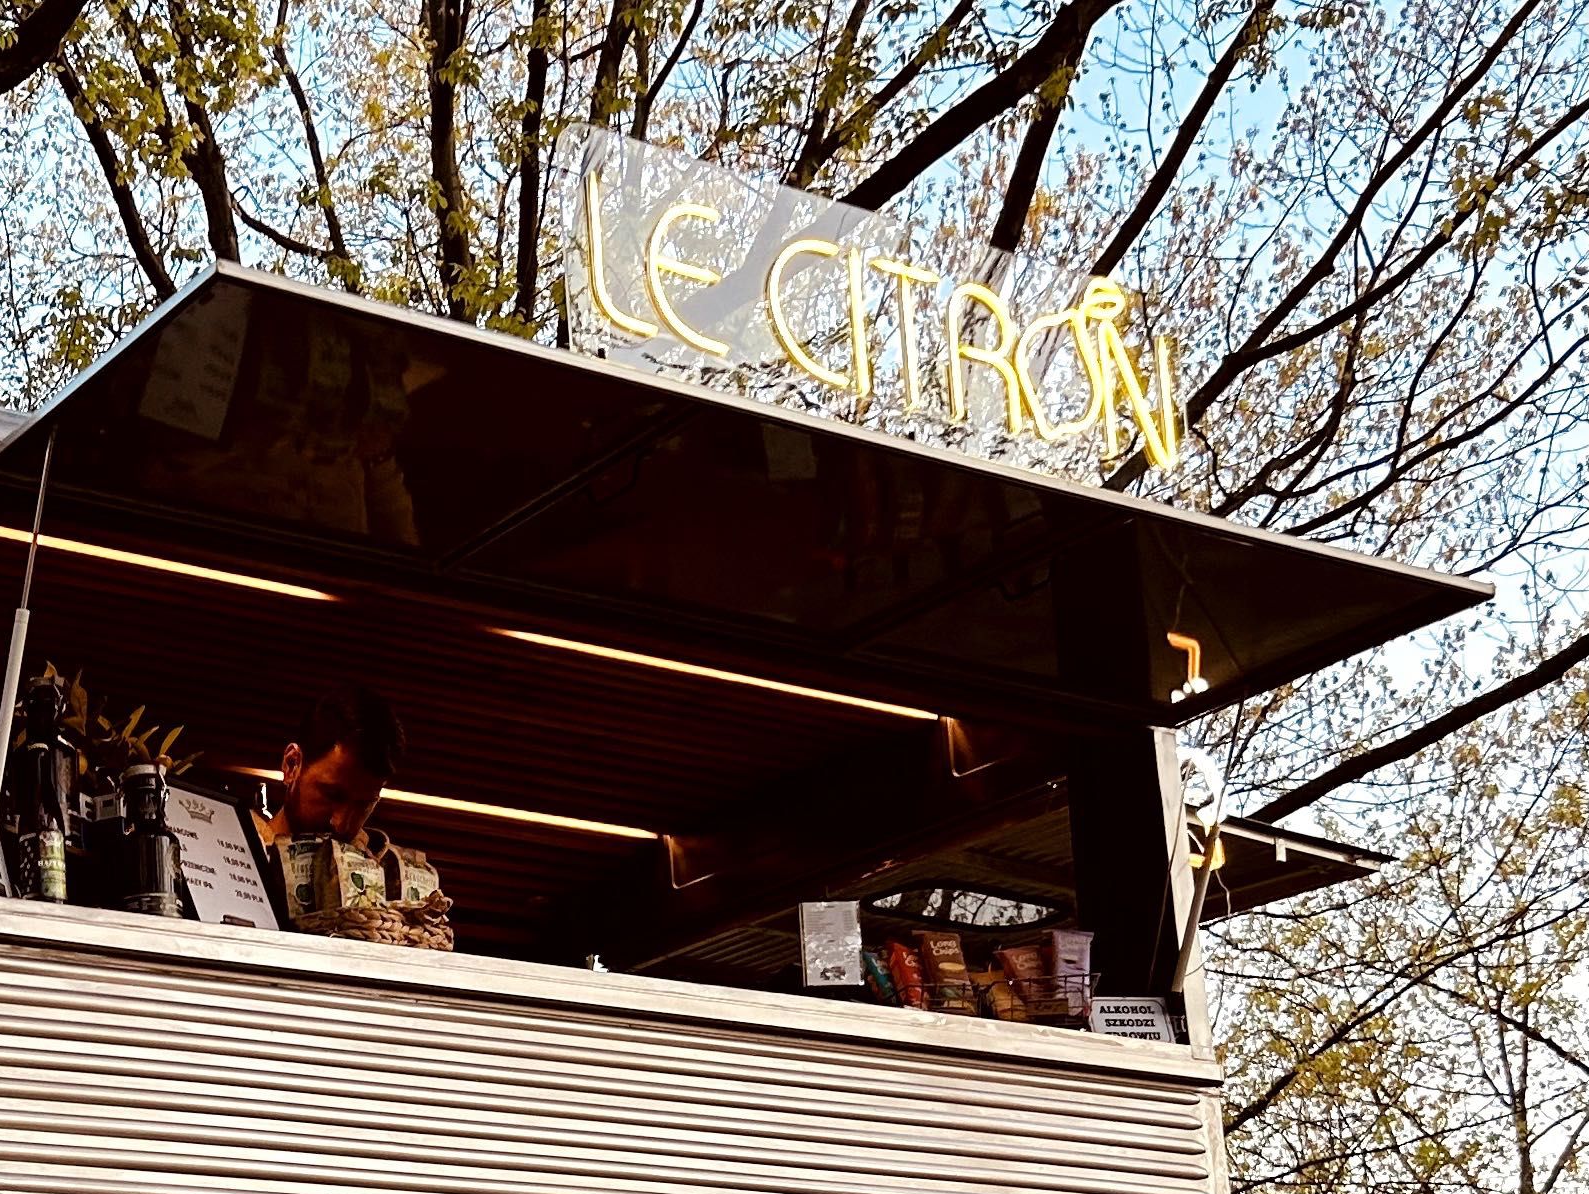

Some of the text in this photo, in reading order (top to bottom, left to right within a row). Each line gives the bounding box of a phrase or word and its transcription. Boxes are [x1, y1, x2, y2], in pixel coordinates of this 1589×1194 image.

[582, 168, 729, 357] LE
[1099, 1005, 1155, 1014] ALKOHOL
[1105, 1018, 1156, 1027] SZKODZI
